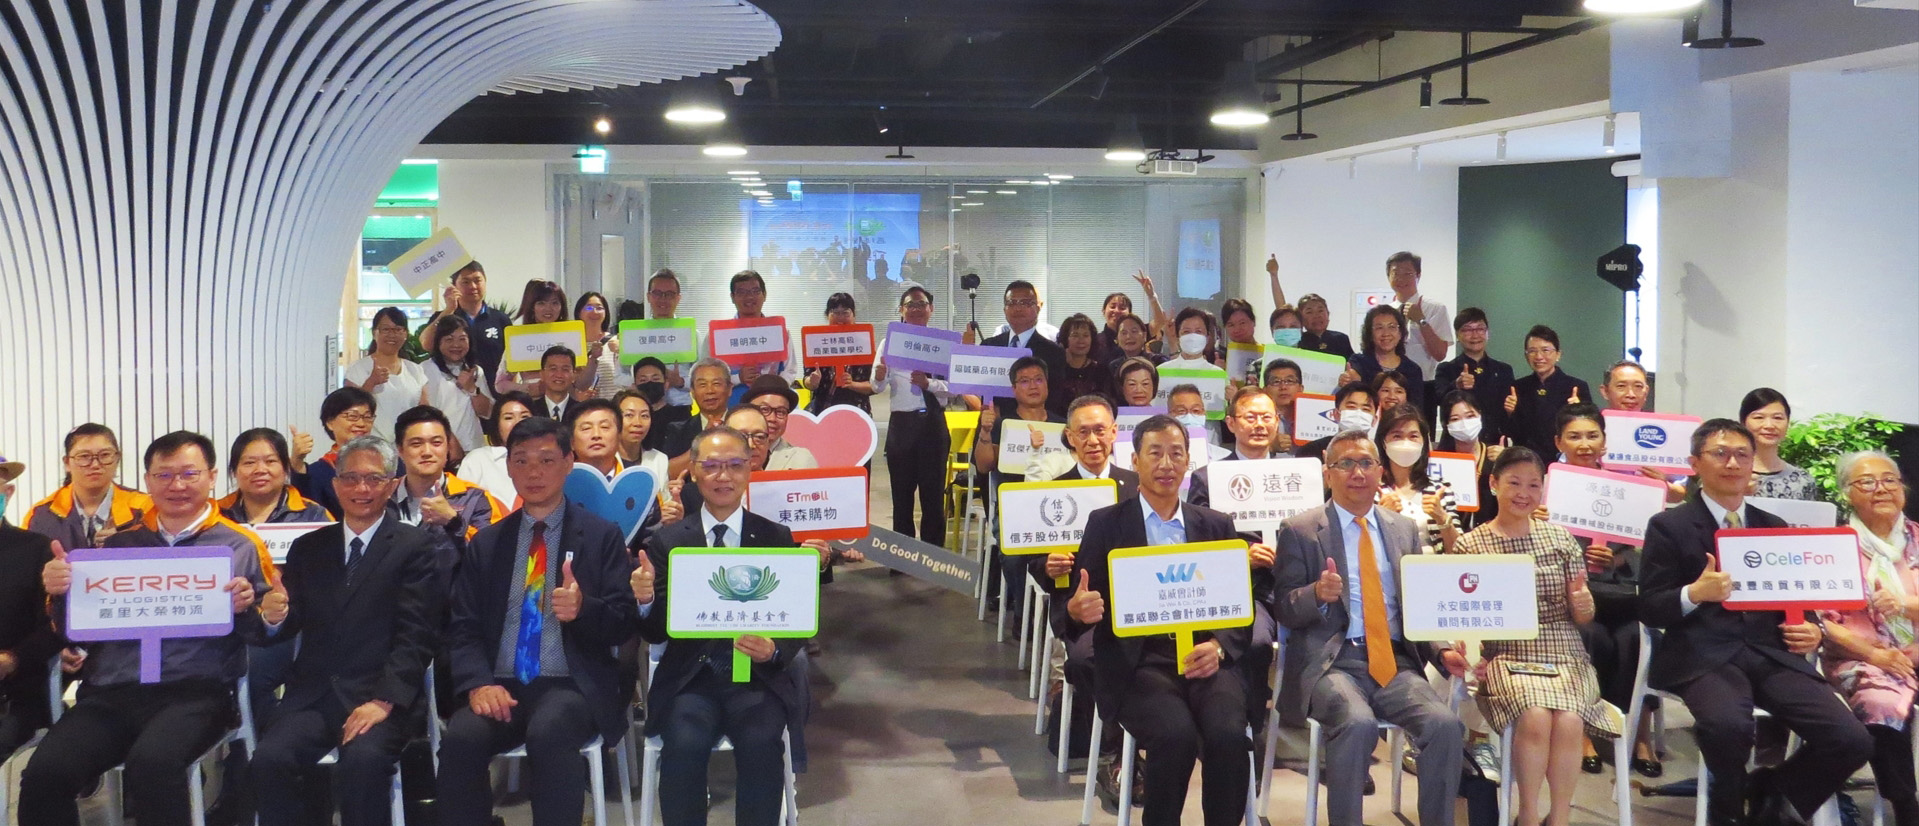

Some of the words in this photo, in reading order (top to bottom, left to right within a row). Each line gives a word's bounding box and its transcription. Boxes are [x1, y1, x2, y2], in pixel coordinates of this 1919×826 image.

[413, 250, 446, 274] 中正高中
[638, 334, 677, 345] 復興高中
[729, 336, 768, 347] 陽明高中
[821, 336, 855, 344] 士林高級
[813, 345, 863, 355] 商業職業學校
[904, 340, 940, 353] 明倫高中
[1262, 473, 1302, 493] 遠睿
[778, 507, 837, 523] 東森購物
[871, 537, 887, 551] Do
[889, 544, 920, 562] Good
[1765, 551, 1835, 566] CeleFon
[85, 574, 217, 594] KERRY
[123, 594, 203, 604] LOGISTICS
[1437, 600, 1503, 611] 永安國際管理
[99, 605, 203, 619] 嘉里大榮物流
[696, 610, 790, 622] 佛教慈濟基金會
[1123, 604, 1241, 624] 嘉威聯合會計師事務所
[1438, 616, 1504, 627] 顧問有限公司
